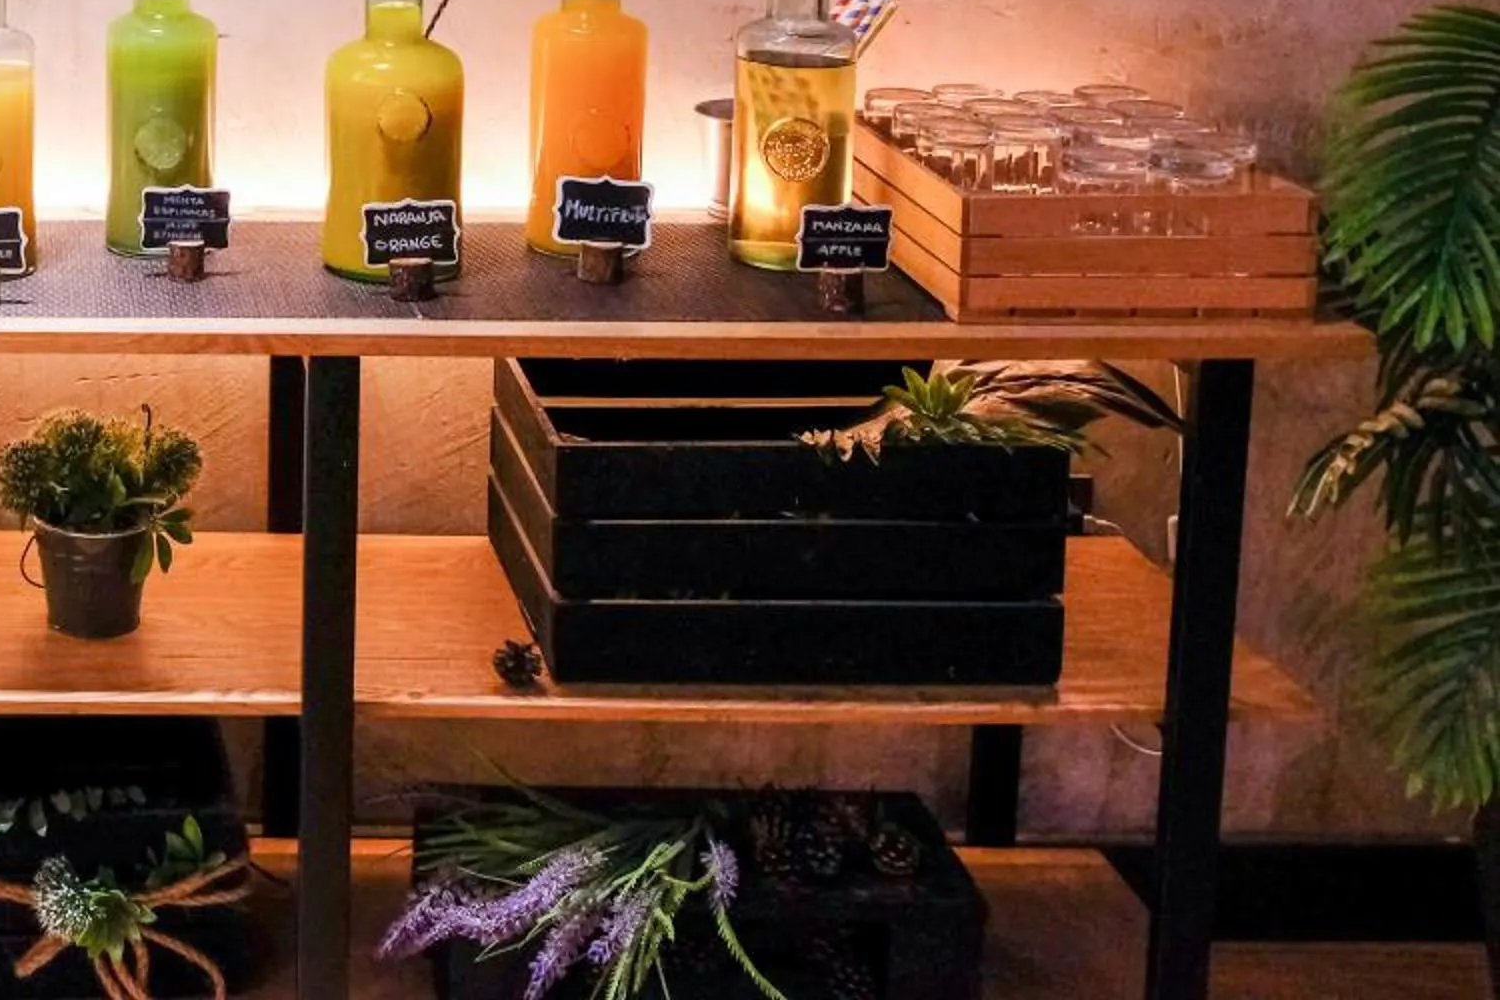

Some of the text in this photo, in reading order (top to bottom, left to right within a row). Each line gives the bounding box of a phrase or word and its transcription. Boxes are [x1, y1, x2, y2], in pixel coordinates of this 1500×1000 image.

[373, 209, 448, 226] NARANJA
[812, 220, 883, 233] MANZANA
[374, 234, 444, 252] ORANGE
[817, 244, 862, 257] APPLE
